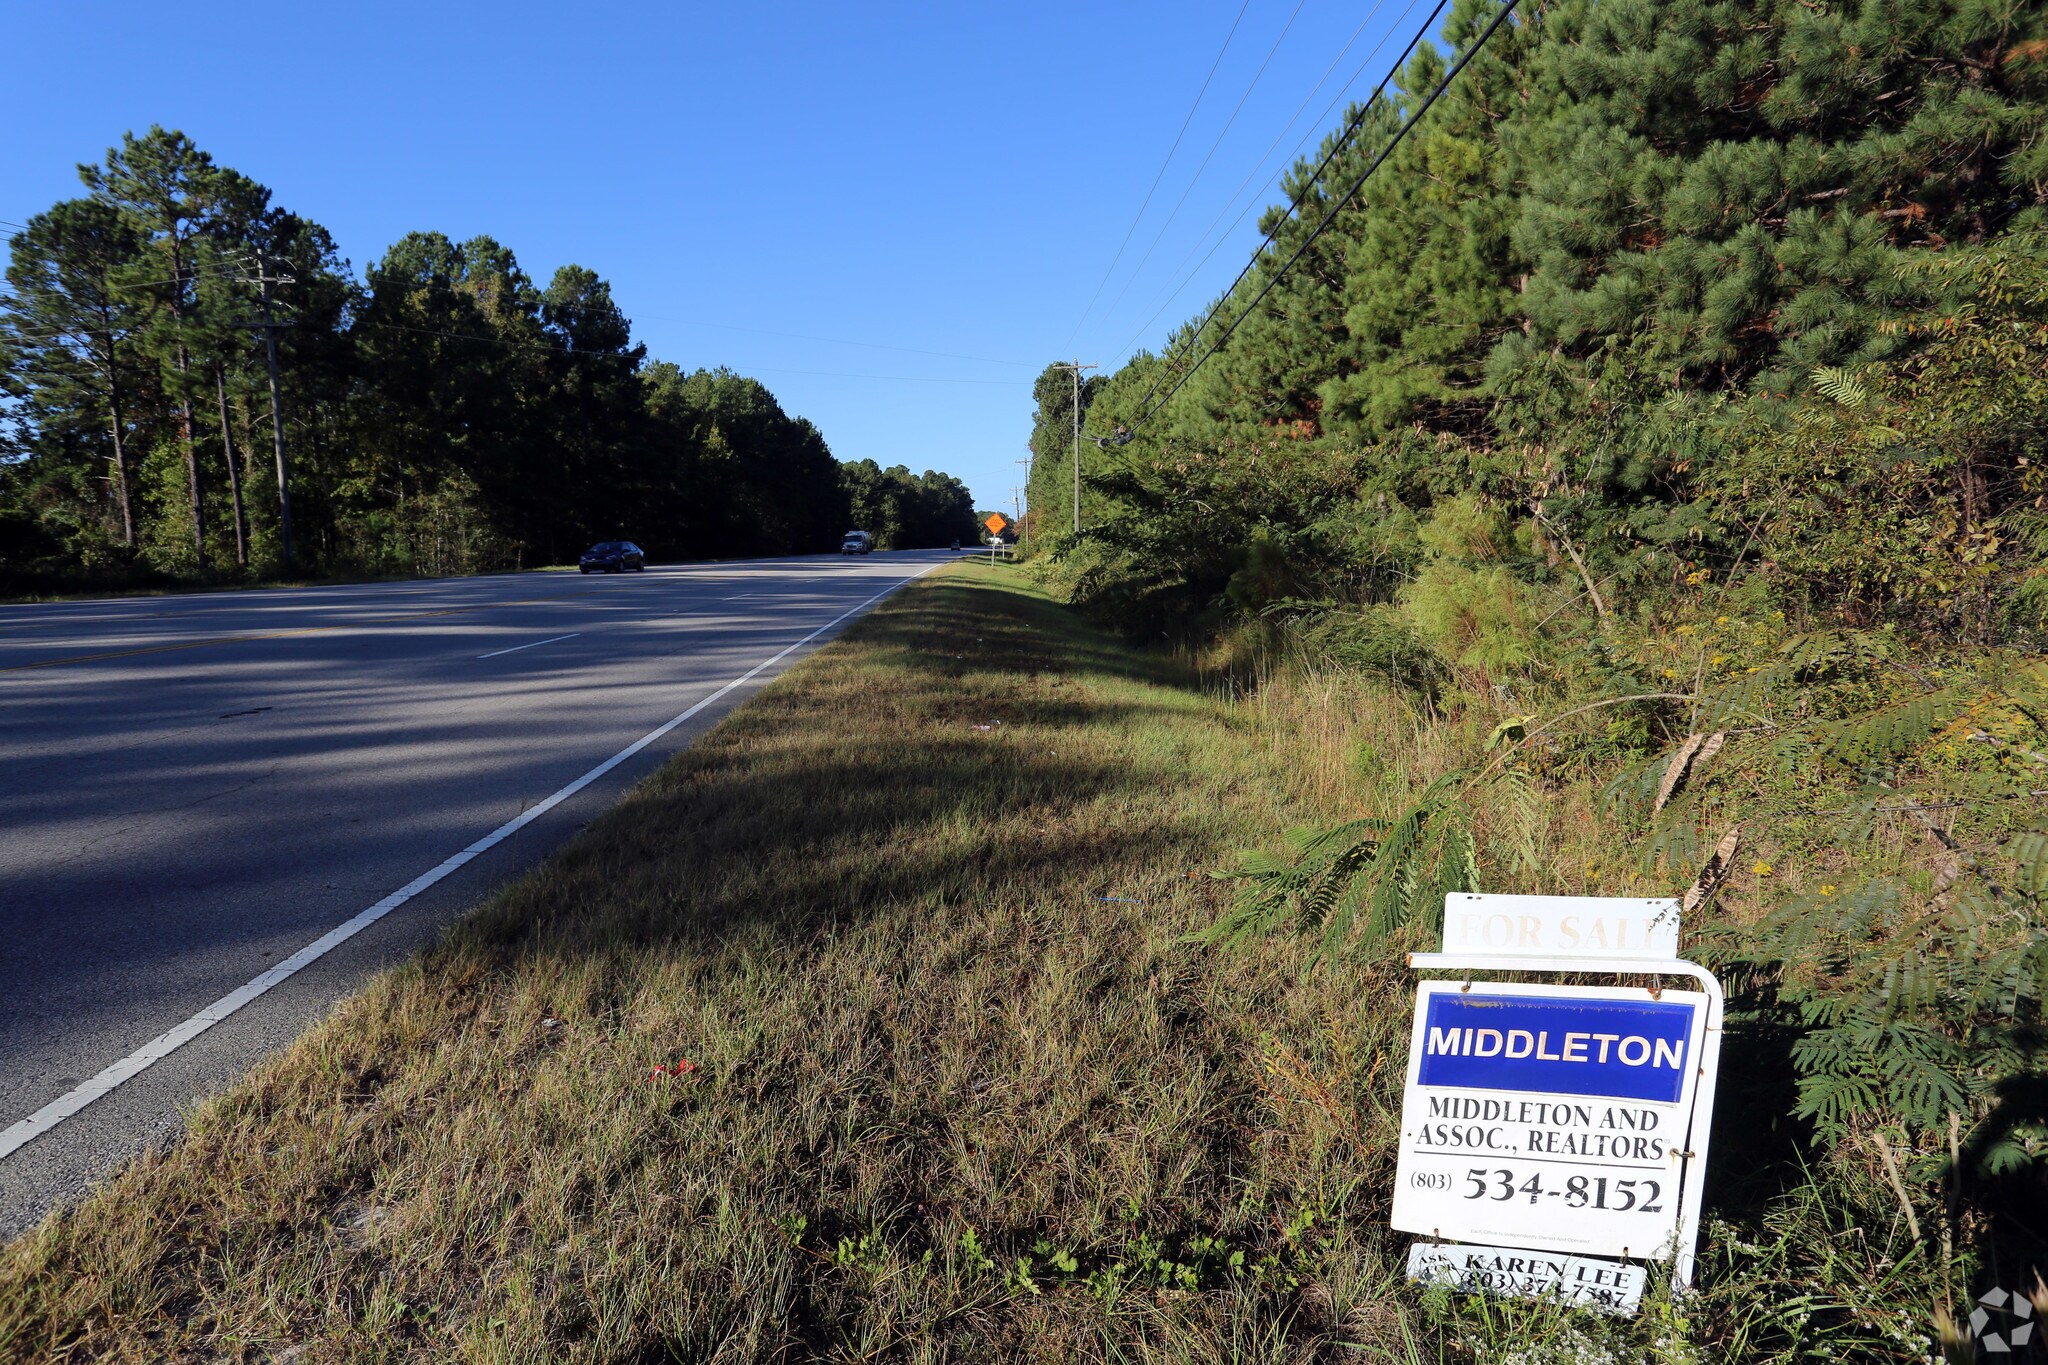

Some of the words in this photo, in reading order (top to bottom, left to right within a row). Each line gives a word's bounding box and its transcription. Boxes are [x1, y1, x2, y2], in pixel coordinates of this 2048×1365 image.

[1457, 913, 1543, 948] FOR
[1427, 1026, 1684, 1070] MIDDLETON
[1428, 1096, 1592, 1127] MIDDLETON
[1599, 1107, 1659, 1131] AND
[1416, 1123, 1517, 1155] ASSOC.,
[1410, 1171, 1452, 1192] (803)
[1464, 1168, 1663, 1213] 534-8152
[1504, 1231, 1537, 1240] Independently
[1465, 1254, 1567, 1277] KAREN
[1576, 1265, 1631, 1289] LEE
